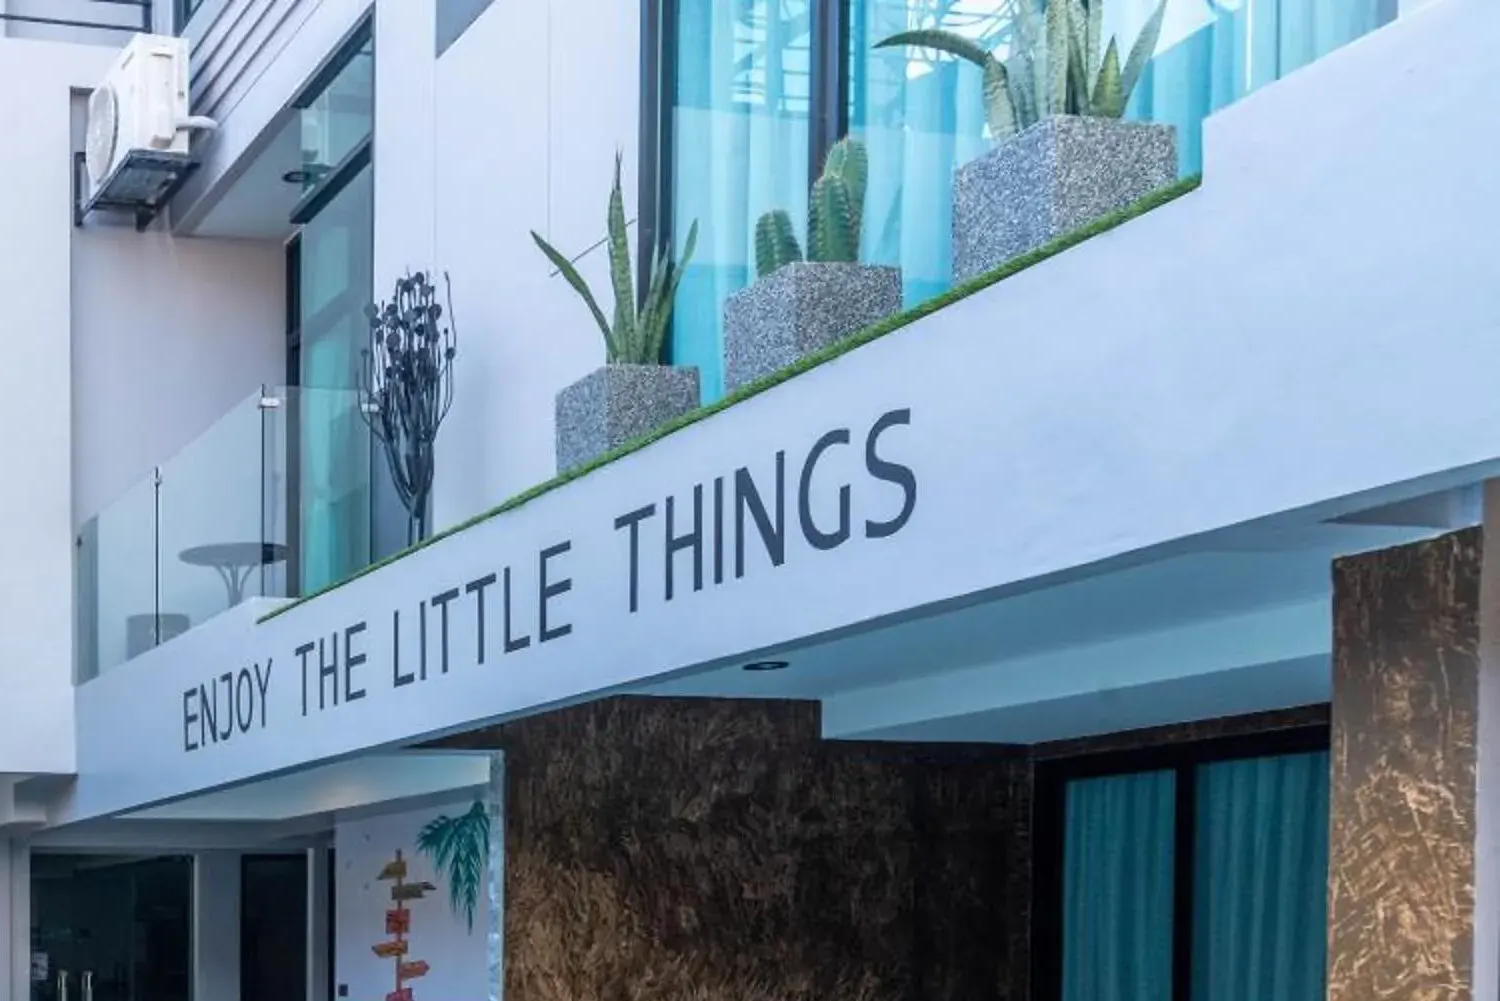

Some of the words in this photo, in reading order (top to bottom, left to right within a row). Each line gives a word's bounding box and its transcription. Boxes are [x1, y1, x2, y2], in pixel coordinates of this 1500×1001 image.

[182, 657, 273, 753] ENJOY
[294, 621, 367, 717] THE
[393, 539, 573, 689] LITTLE
[613, 407, 917, 614] THINGS
